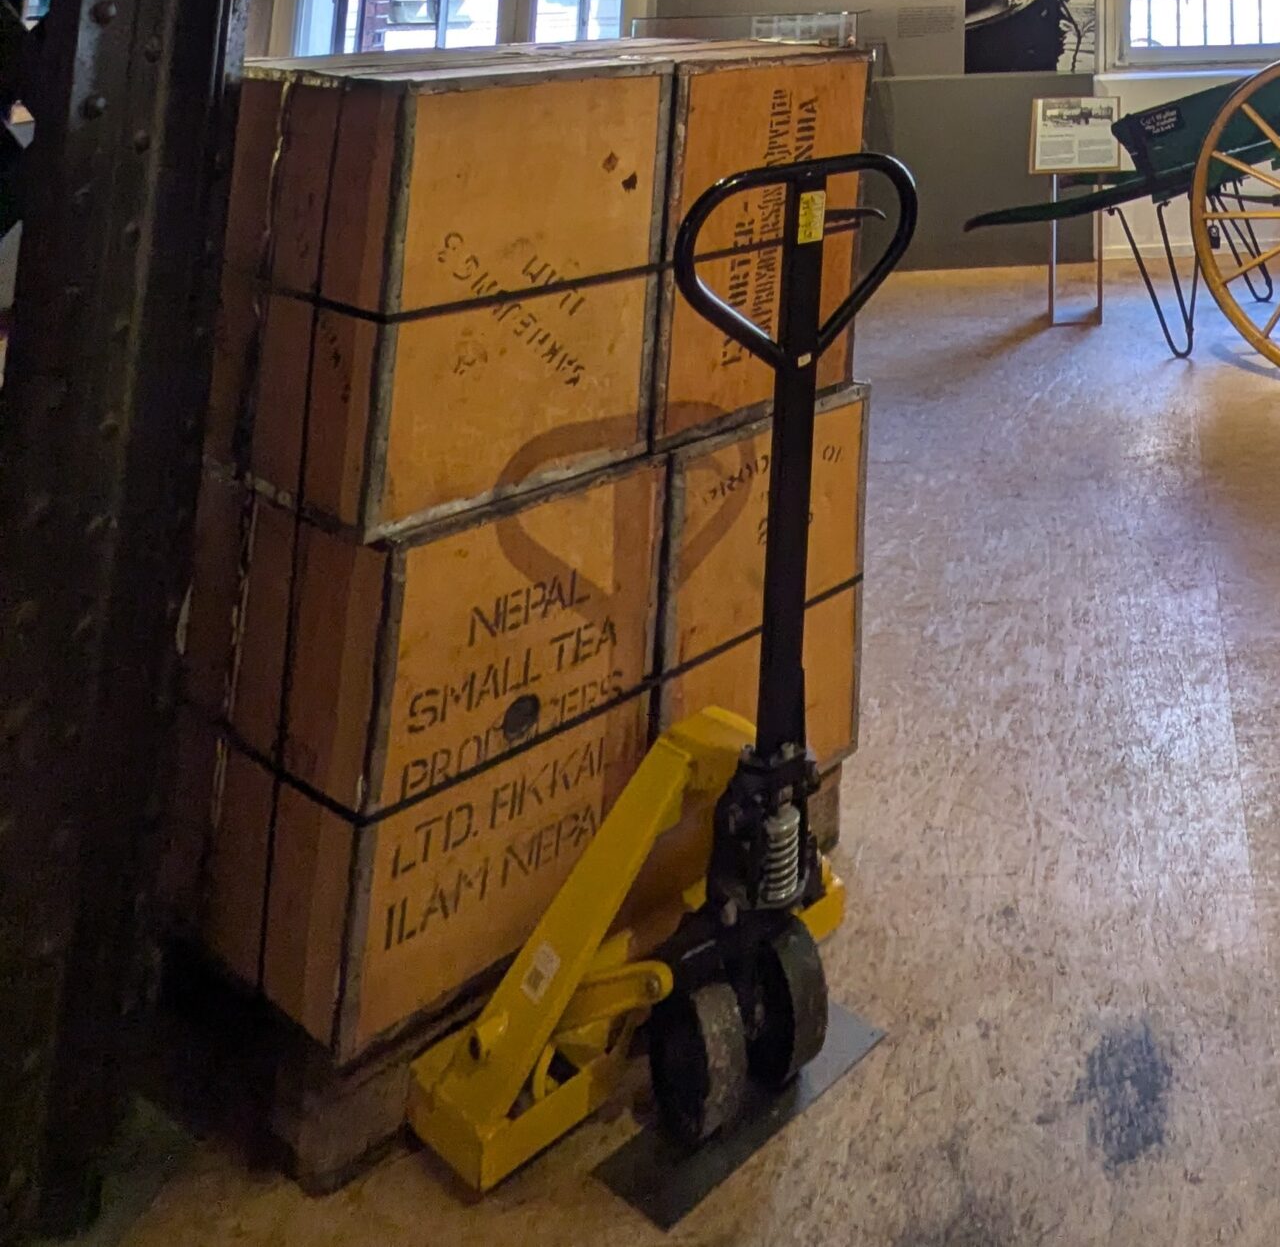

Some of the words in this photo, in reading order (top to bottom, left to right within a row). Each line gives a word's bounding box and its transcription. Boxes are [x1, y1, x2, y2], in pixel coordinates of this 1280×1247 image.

[794, 95, 819, 163] NDIA
[720, 219, 755, 367] EXORTER
[467, 568, 592, 647] NEPAL
[406, 644, 545, 734] SMALL
[550, 614, 618, 671] TEA
[399, 669, 626, 801] PRODERS
[383, 858, 491, 951] ILAM
[501, 804, 600, 888] NEPA
[391, 802, 479, 879] LTD.
